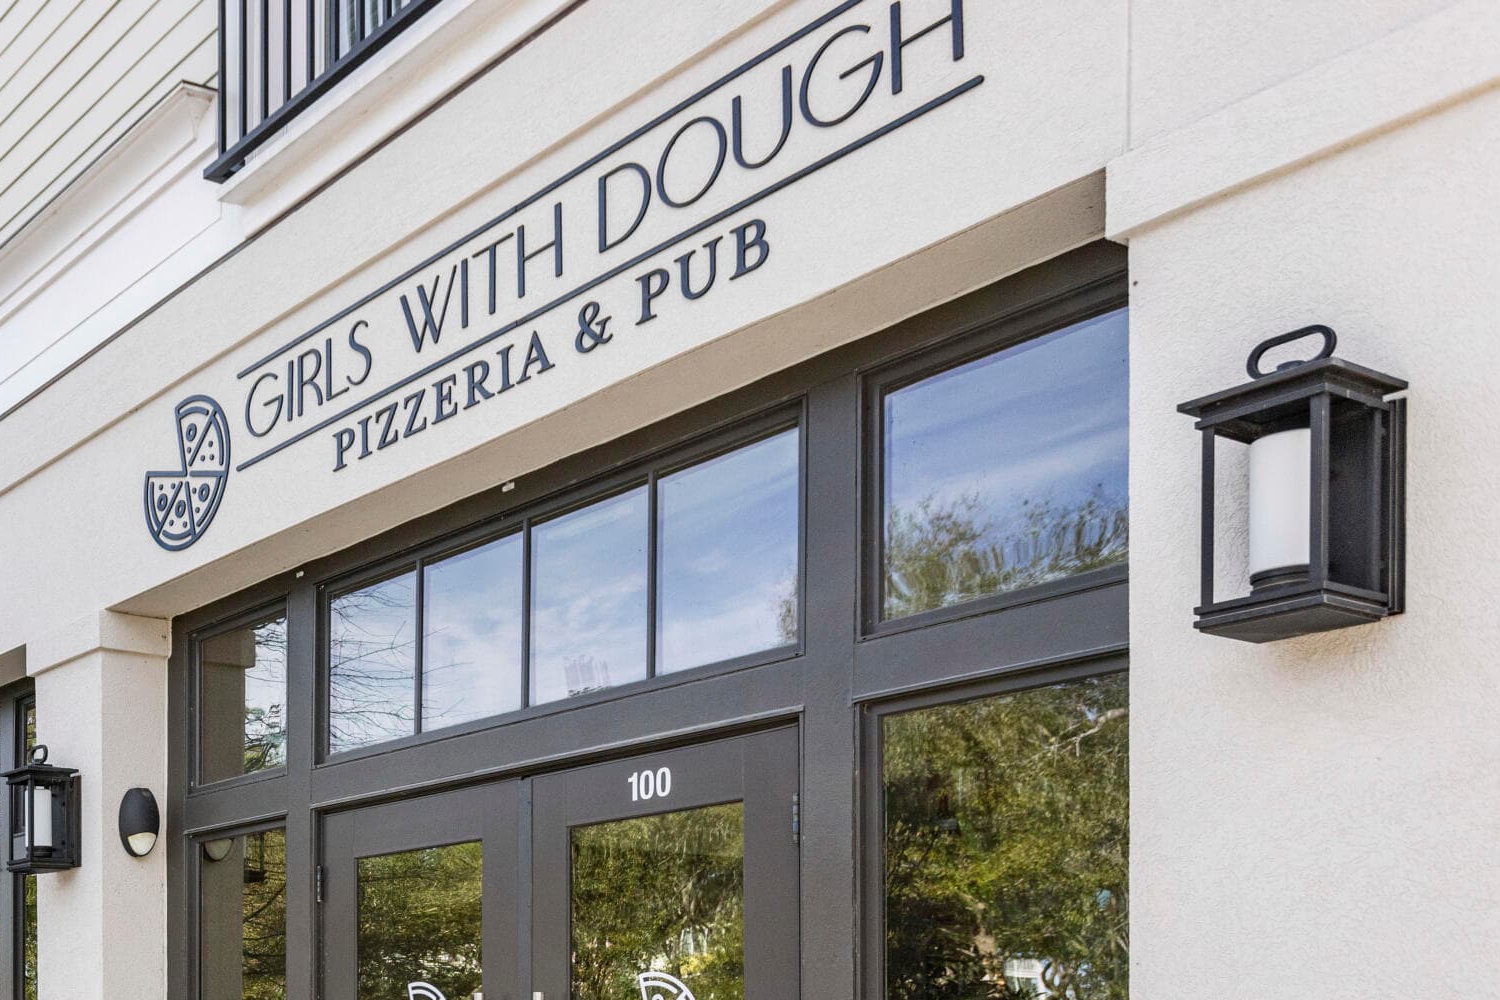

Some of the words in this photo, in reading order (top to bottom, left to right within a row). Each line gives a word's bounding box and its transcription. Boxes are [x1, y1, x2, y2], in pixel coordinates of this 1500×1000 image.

[244, 319, 374, 439] GIRLS
[399, 201, 564, 354] WITH
[596, 0, 967, 255] DOUGH
[333, 329, 555, 473] PIZZERIA
[574, 300, 615, 355] &
[636, 218, 771, 328] PUB
[627, 767, 672, 802] 100
